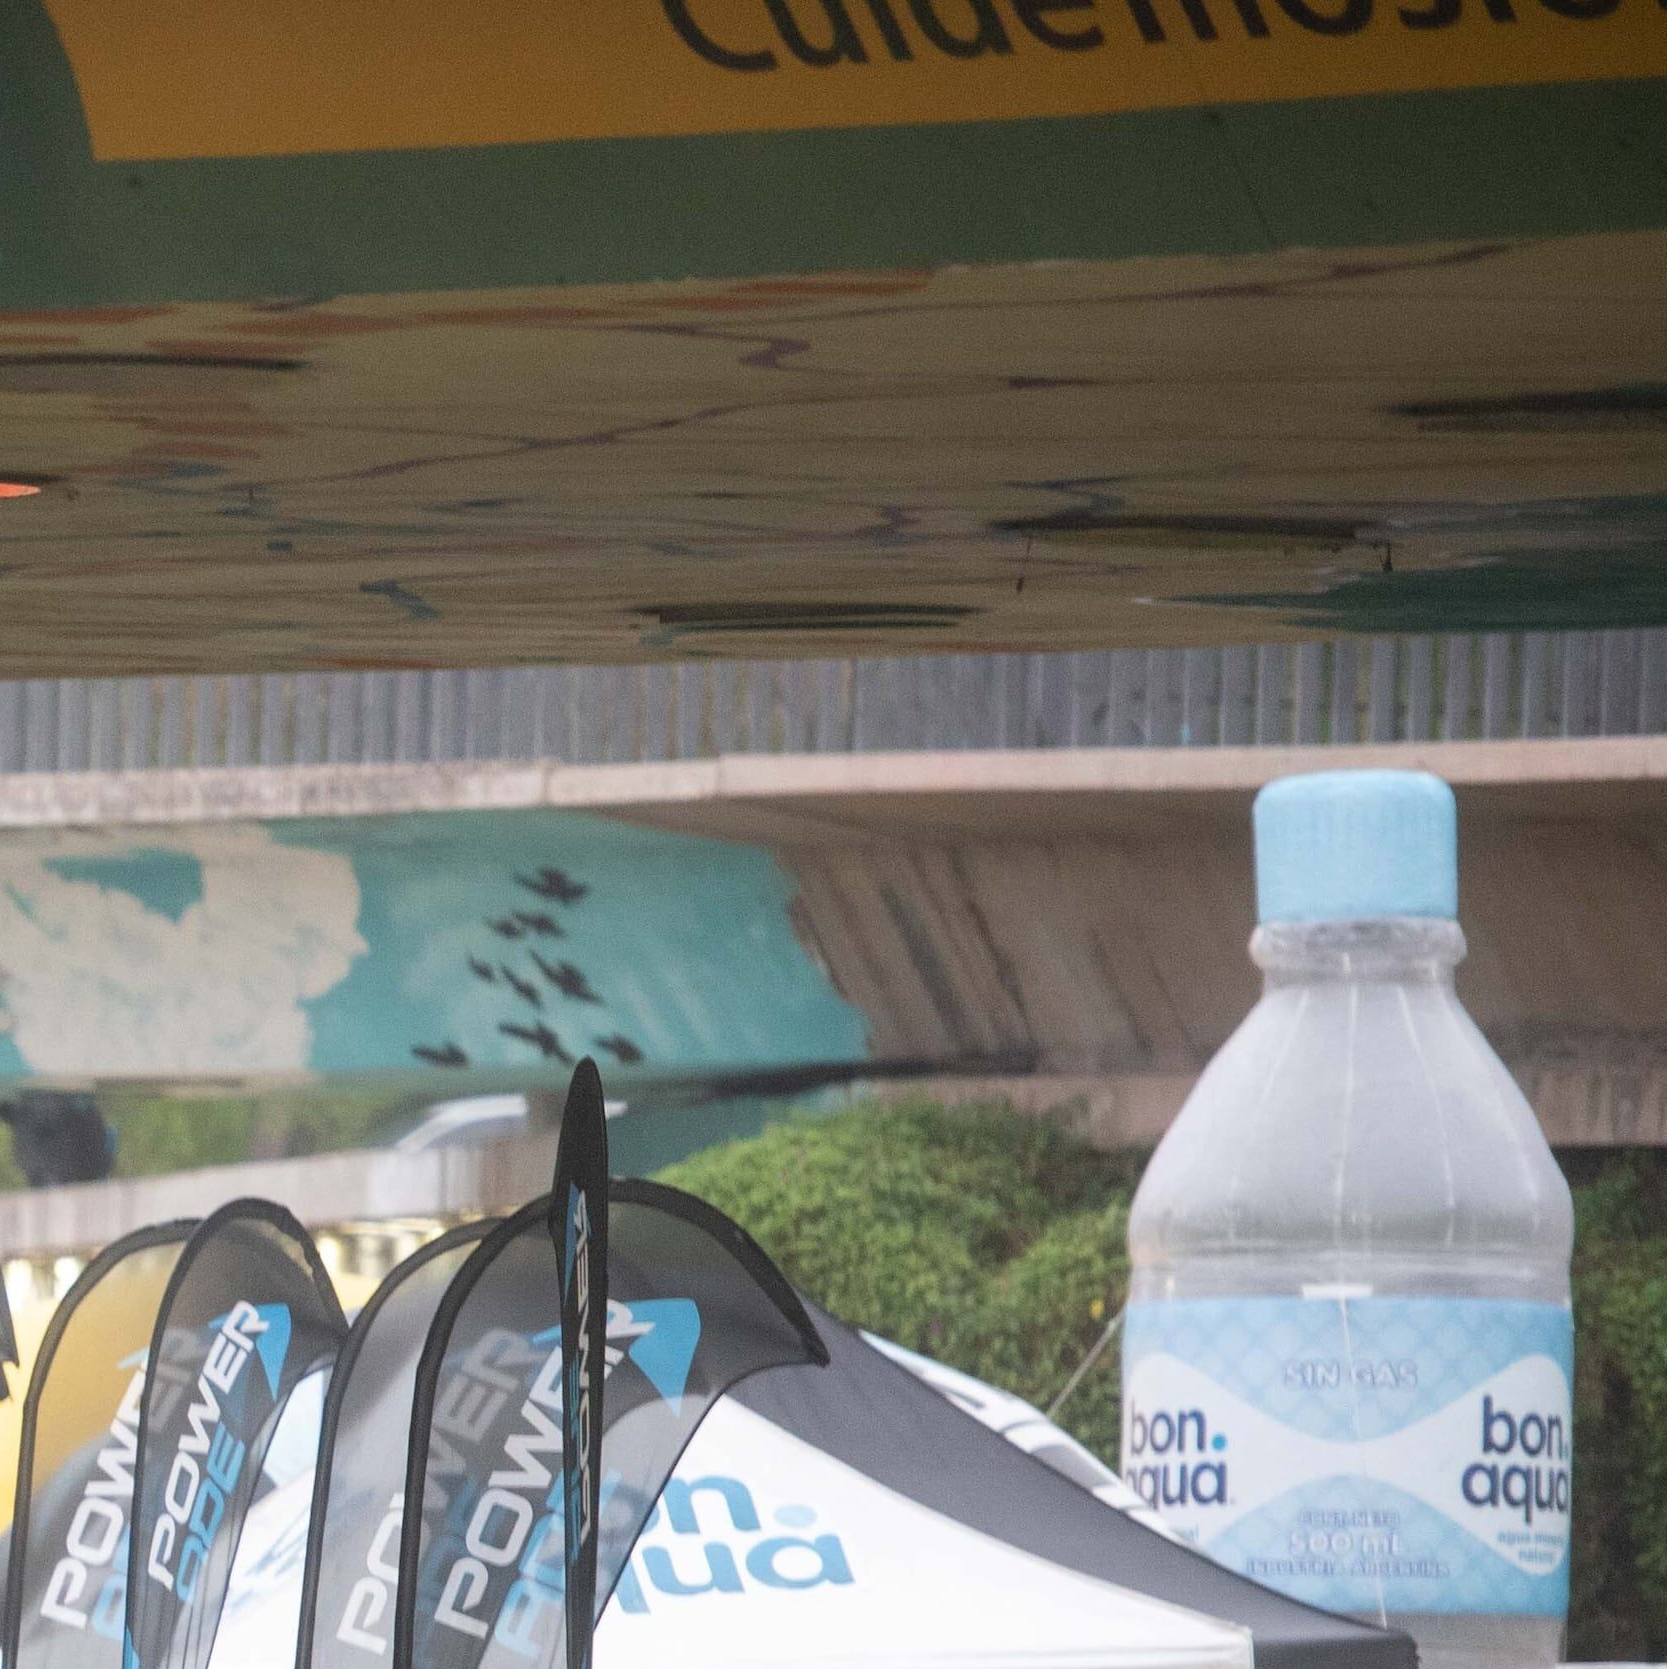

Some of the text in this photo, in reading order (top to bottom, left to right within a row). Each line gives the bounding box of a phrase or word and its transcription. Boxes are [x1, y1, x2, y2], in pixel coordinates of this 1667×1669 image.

[148, 1299, 270, 1592] POWER
[1283, 1357, 1419, 1390] SIN GAS
